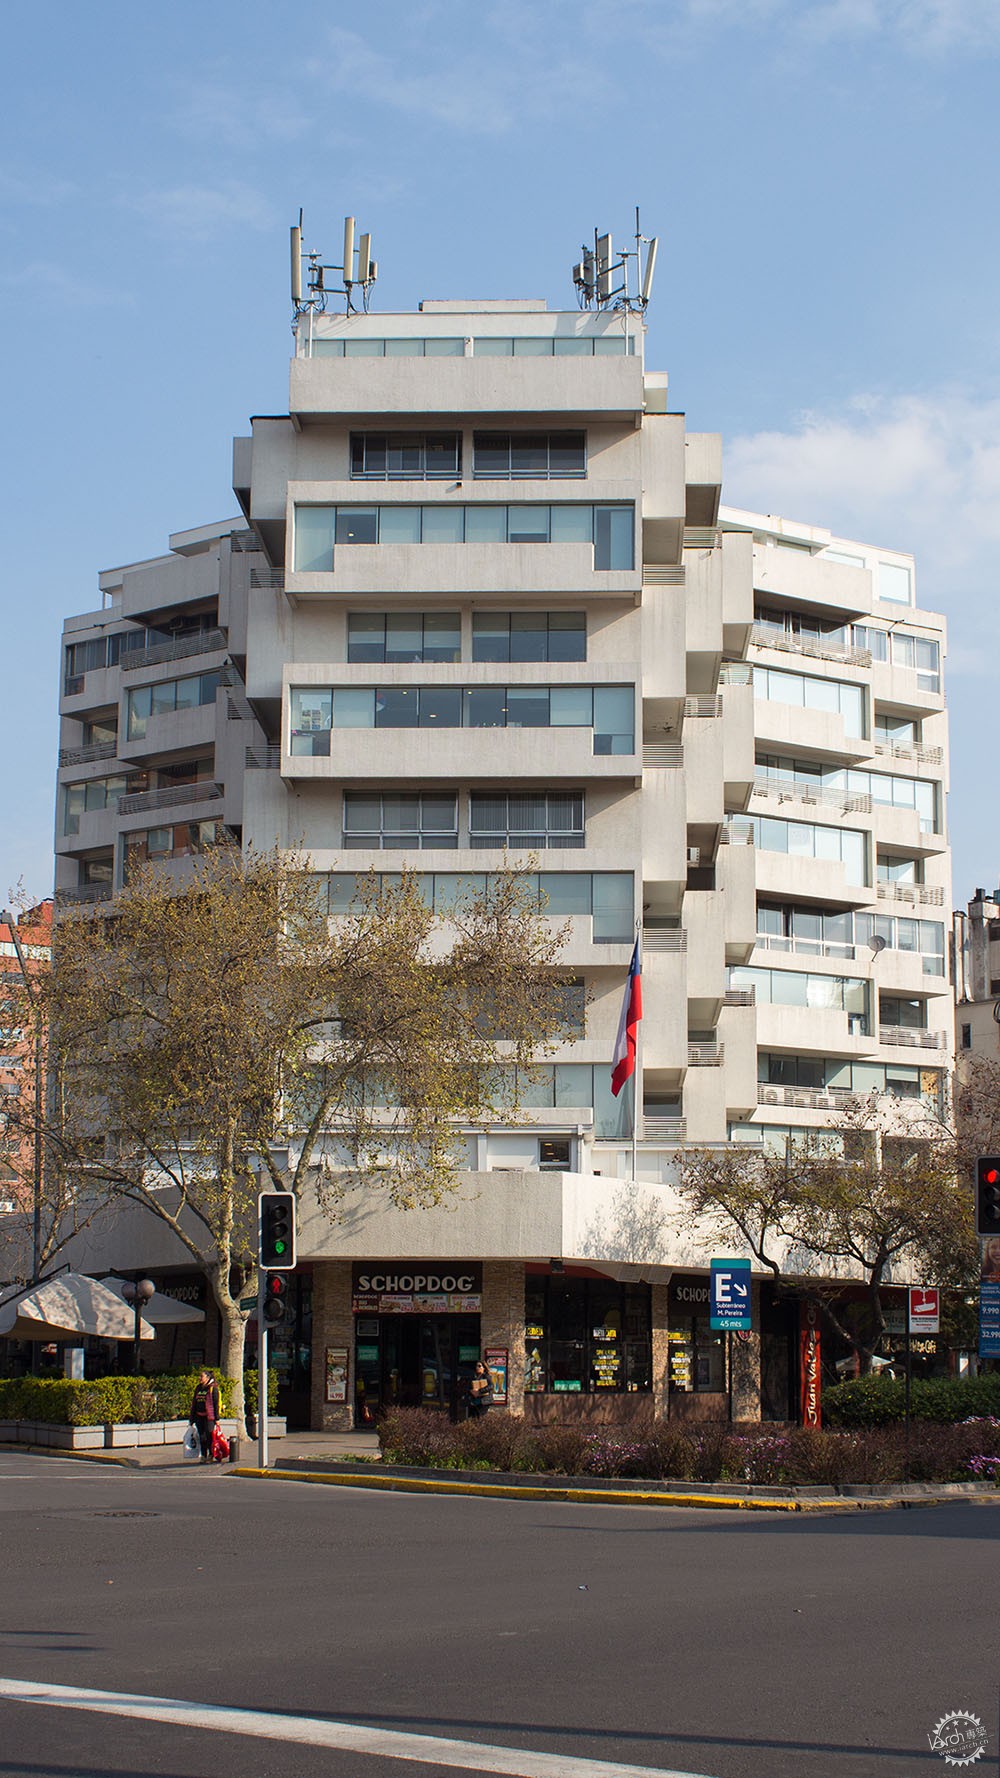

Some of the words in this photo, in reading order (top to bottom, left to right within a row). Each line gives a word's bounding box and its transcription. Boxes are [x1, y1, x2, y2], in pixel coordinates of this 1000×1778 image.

[676, 1286, 710, 1303] SCHOP
[716, 1273, 732, 1302] E
[720, 1320, 730, 1328] 45
[807, 1383, 818, 1425] Juan
